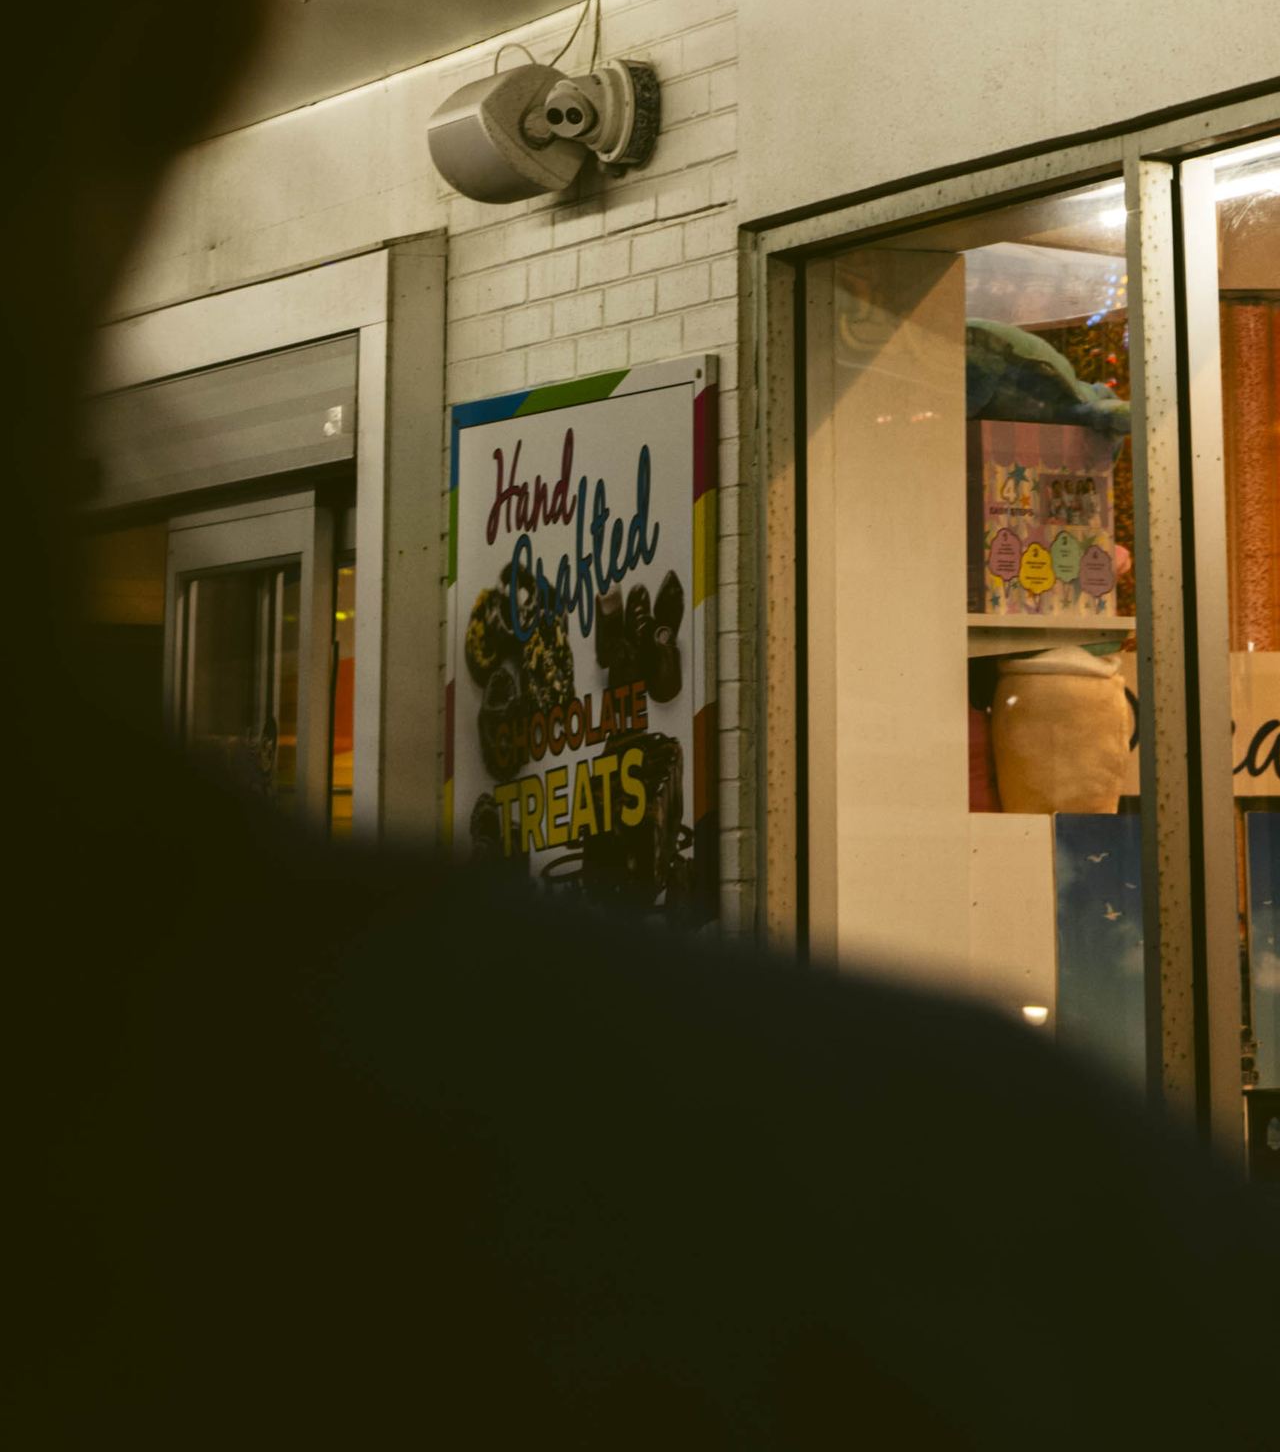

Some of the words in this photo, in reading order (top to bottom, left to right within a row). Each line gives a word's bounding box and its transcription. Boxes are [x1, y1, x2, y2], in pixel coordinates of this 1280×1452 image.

[487, 427, 578, 546] Hand
[508, 444, 660, 645] Crafted
[495, 679, 649, 767] CHOCOLATE
[493, 746, 648, 860] TREATS
